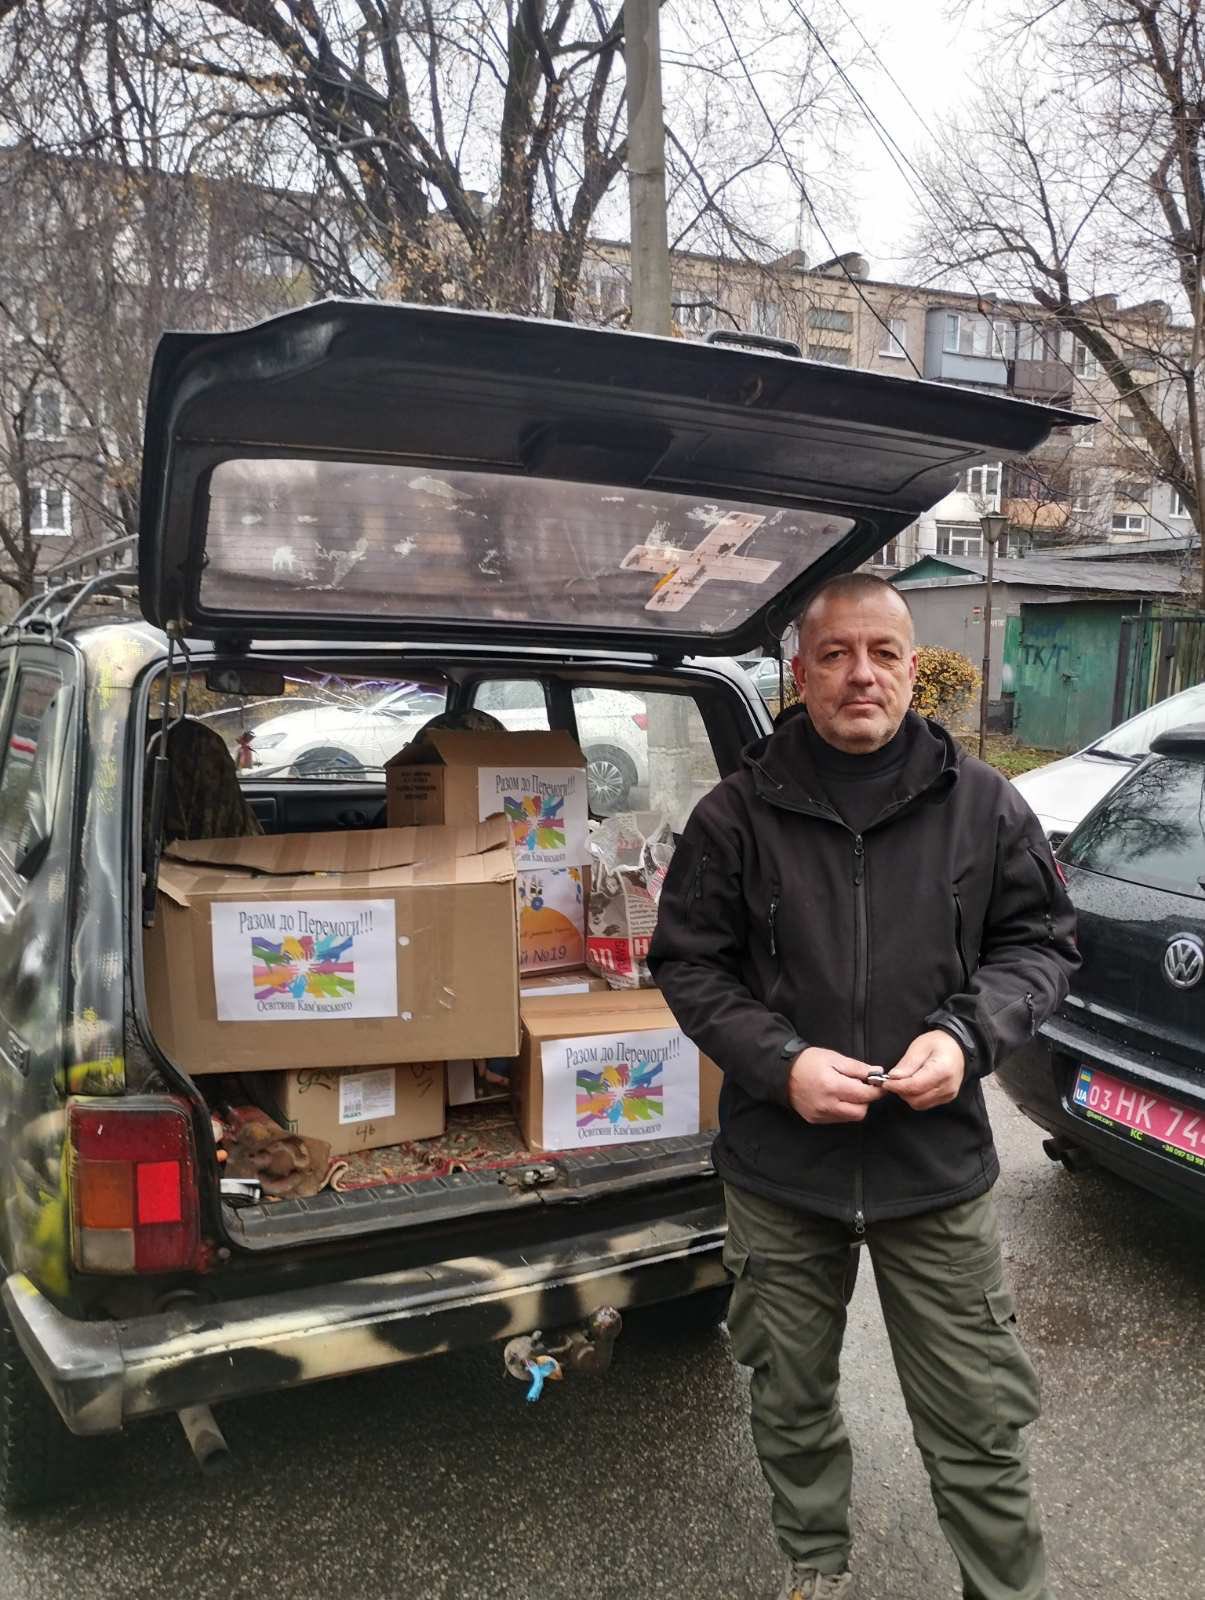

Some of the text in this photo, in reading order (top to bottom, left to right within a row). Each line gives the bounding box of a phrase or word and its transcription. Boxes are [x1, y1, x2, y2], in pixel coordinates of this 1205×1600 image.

[496, 774, 519, 794] Разом
[239, 910, 373, 939] Разом до Перемоги!!!
[566, 1037, 680, 1068] Разом до Перемоги!!!
[1076, 1089, 1087, 1102] UA
[1089, 1085, 1112, 1111] 03
[1165, 1106, 1205, 1147] 74
